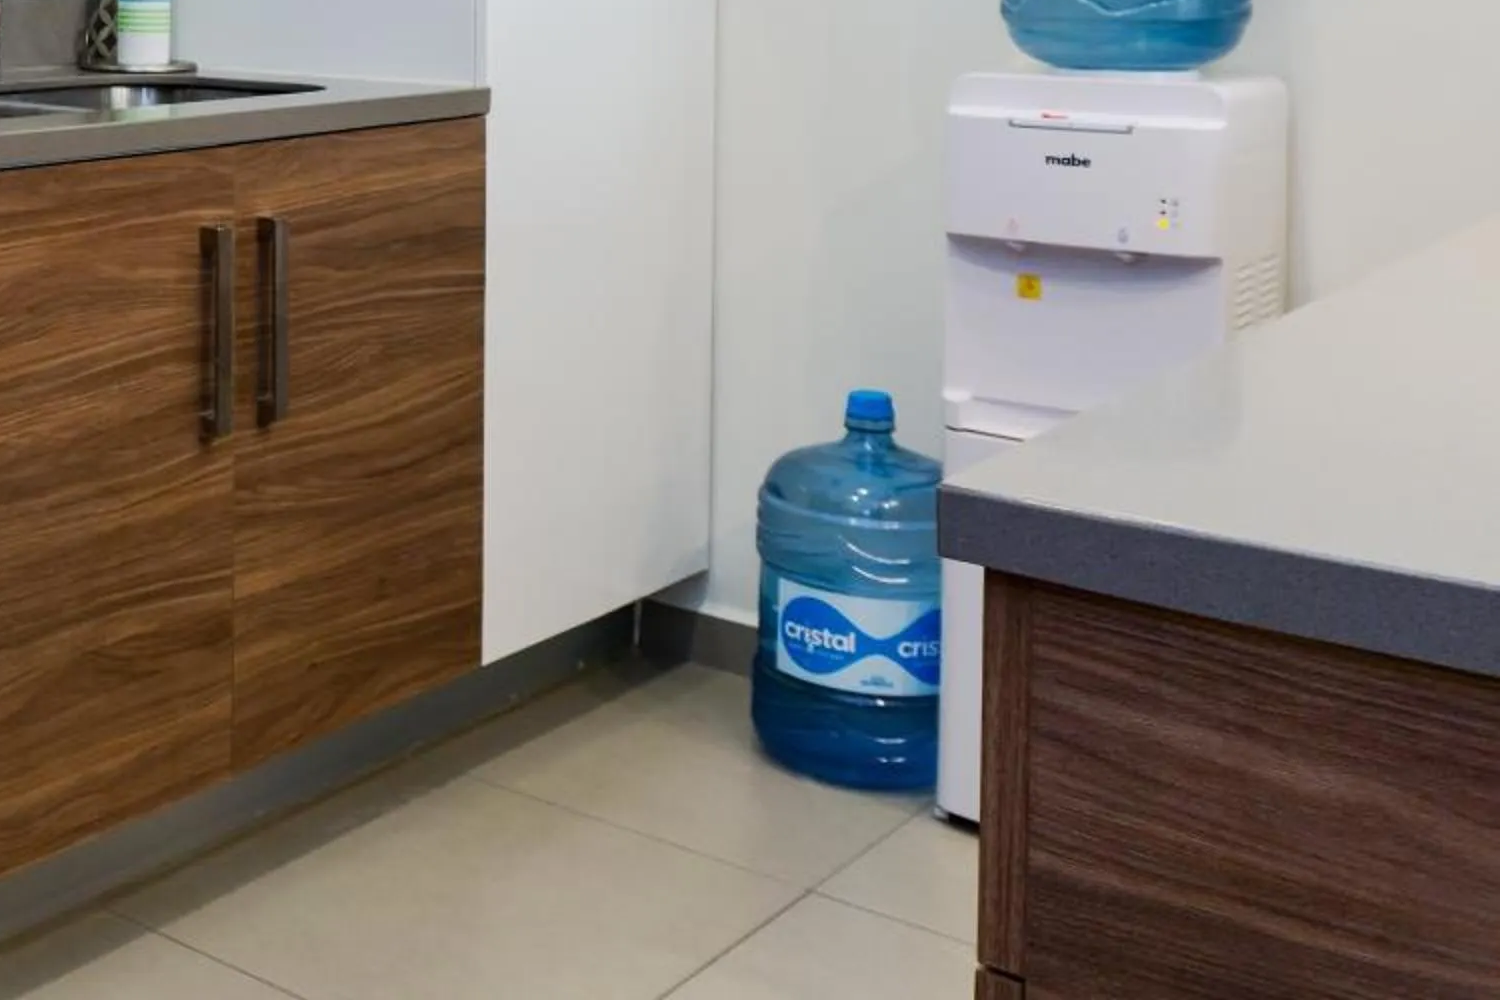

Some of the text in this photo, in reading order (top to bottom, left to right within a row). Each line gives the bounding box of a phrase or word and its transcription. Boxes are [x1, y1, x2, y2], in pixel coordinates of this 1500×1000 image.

[1045, 153, 1092, 168] mabe
[784, 620, 856, 654] cristal
[897, 636, 940, 659] cris
